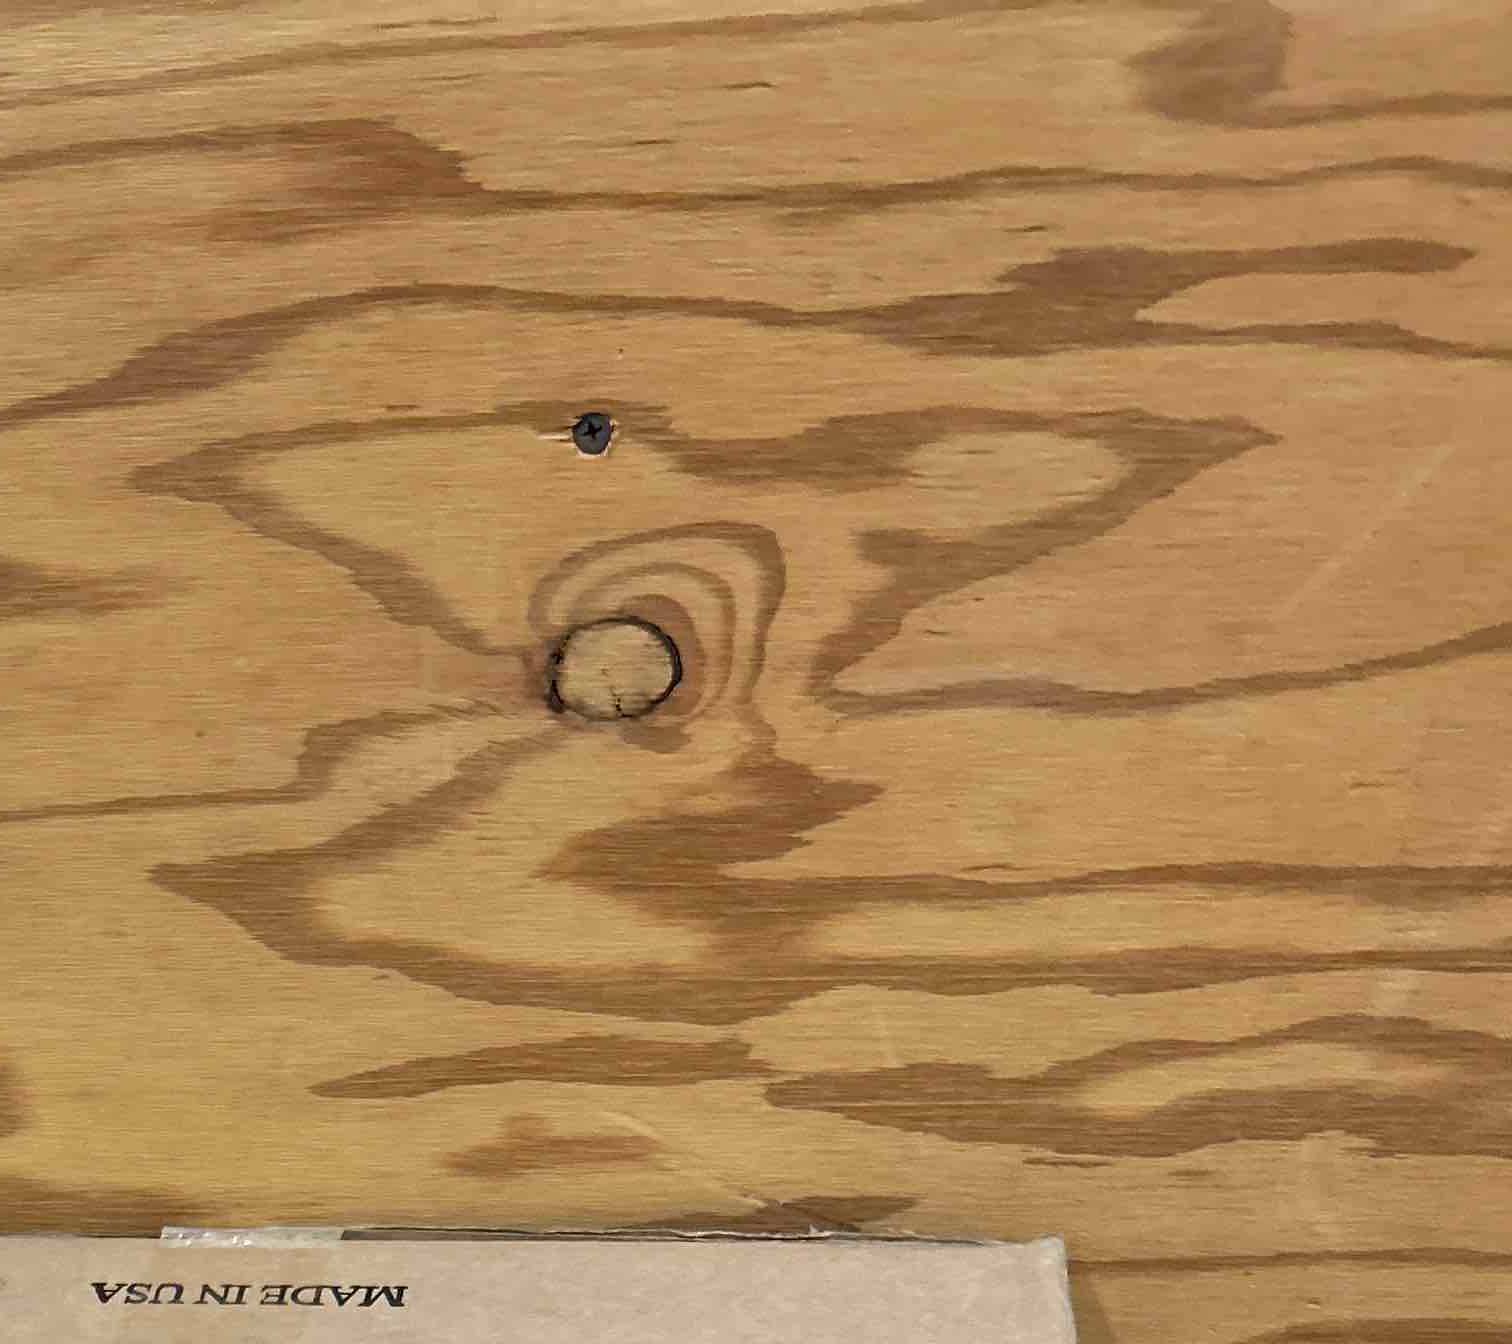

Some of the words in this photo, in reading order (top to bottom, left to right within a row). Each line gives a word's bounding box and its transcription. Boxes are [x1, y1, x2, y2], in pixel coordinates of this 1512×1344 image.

[90, 1282, 185, 1305] USA
[192, 1283, 252, 1306] IN
[259, 1284, 409, 1308] MADE
